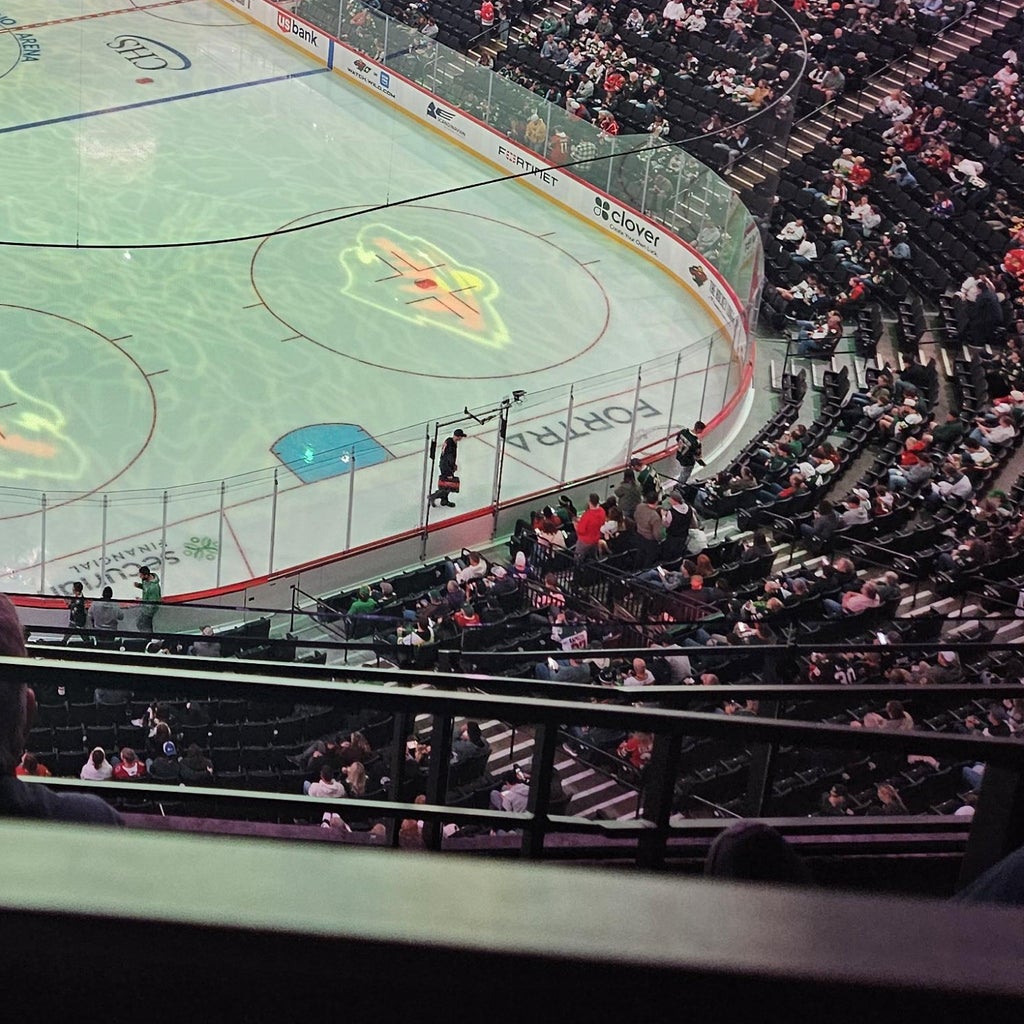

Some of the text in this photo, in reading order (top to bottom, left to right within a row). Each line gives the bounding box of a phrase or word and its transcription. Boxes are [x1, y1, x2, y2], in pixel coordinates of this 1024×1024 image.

[278, 13, 318, 47] us bank
[16, 32, 42, 63] ARENA
[105, 37, 169, 71] CHS
[347, 66, 396, 99] WATCH.WILD.COM
[498, 145, 559, 187] FORTINET
[611, 208, 660, 248] clover
[506, 398, 664, 453] FORTRA
[68, 539, 168, 574] FINANCIAL
